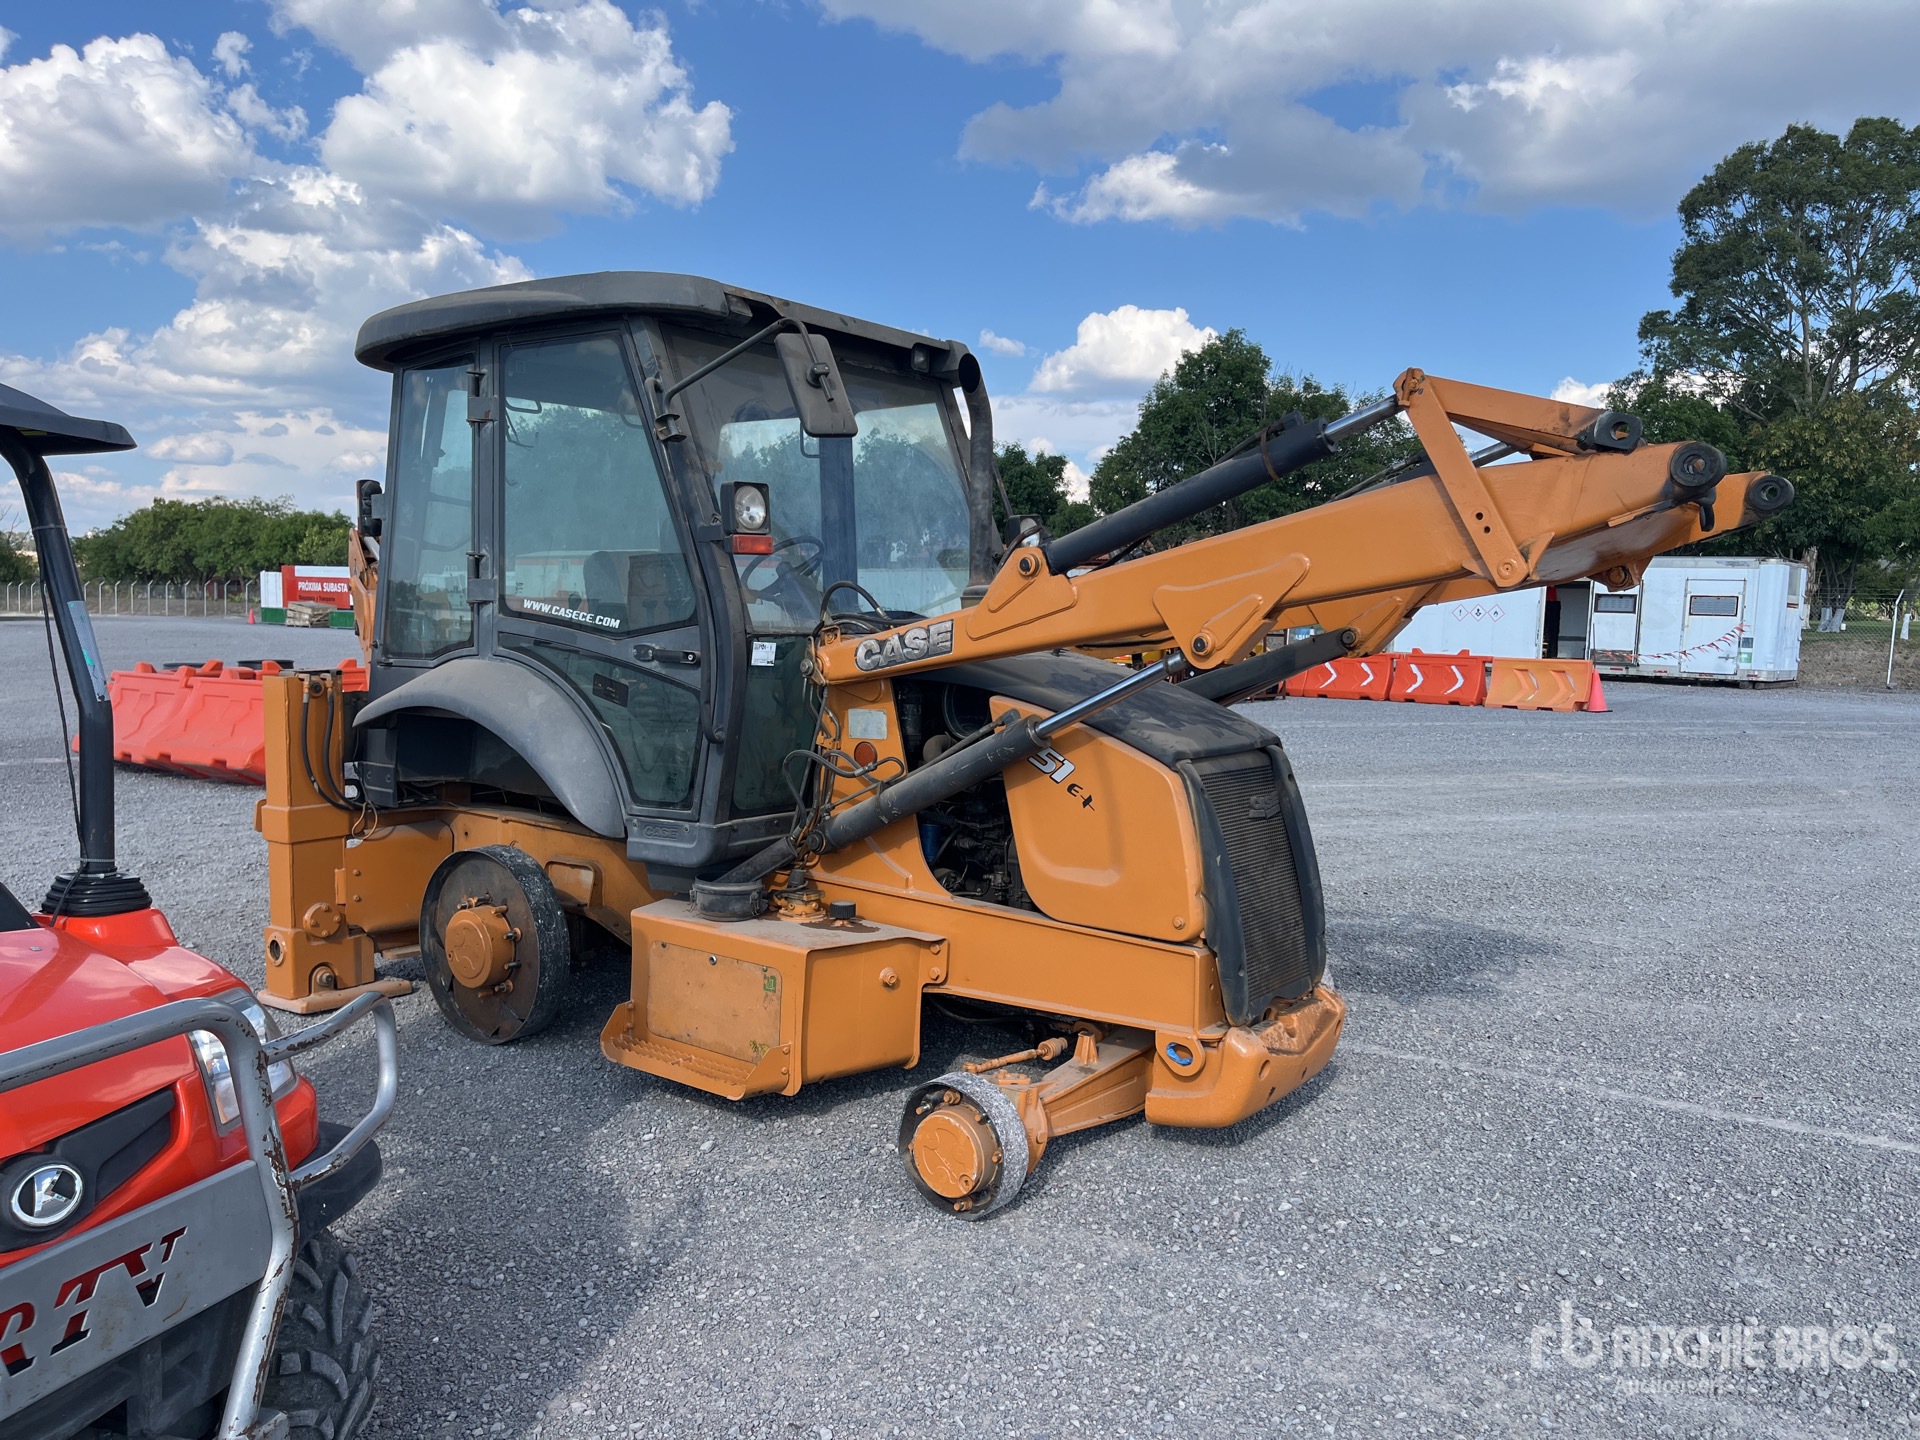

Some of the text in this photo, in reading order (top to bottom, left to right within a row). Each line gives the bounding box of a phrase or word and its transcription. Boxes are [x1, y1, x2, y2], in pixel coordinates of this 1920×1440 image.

[298, 580, 348, 593] PRÓXIMA SUBASTA
[523, 599, 621, 629] WWW.CASECE.COM
[855, 619, 954, 671] CASE
[643, 825, 679, 840] CASE
[0, 1226, 188, 1377] RTV
